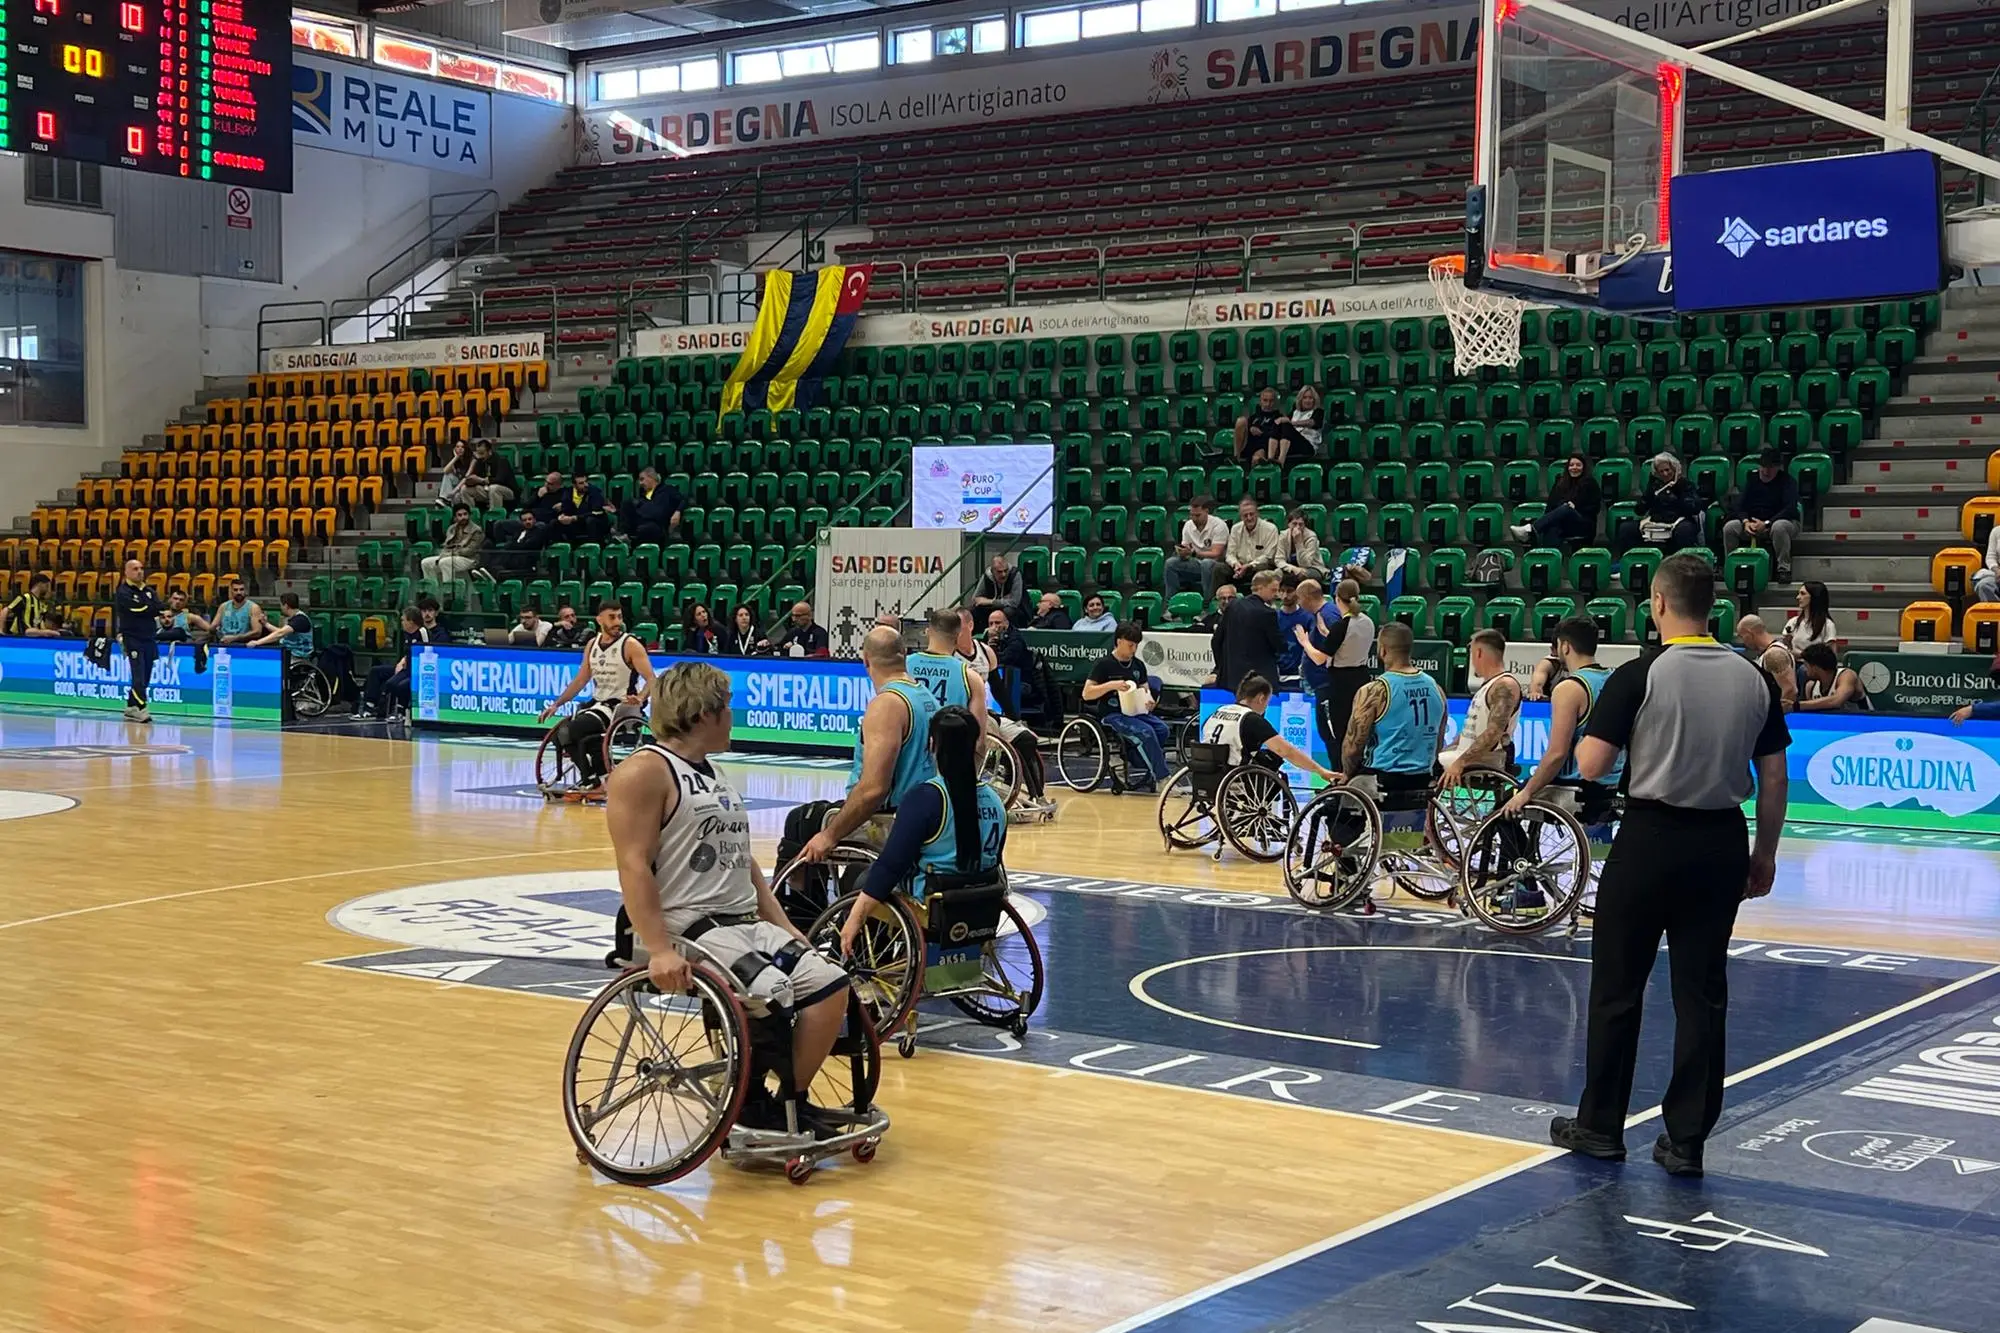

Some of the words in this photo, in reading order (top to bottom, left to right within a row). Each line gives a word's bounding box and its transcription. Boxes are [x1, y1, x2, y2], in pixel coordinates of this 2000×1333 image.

[121, 2, 143, 32] 10
[1206, 17, 1479, 91] SARDEGNA
[344, 76, 477, 136] REALE
[612, 100, 819, 155] SARDEGNA
[830, 102, 893, 128] ISOLA
[898, 80, 1067, 121] dell'Artigianato
[37, 111, 54, 140] 0
[127, 126, 143, 154] 0
[344, 117, 477, 164] MUTUA
[1765, 216, 1888, 247] sardares
[1216, 299, 1336, 322] SARDEGNA
[1341, 300, 1377, 313] ISOLA
[931, 316, 1033, 338] SARDEGNA
[1039, 317, 1068, 331] ISOLA
[677, 331, 753, 350] SARDEGN
[287, 351, 358, 369] SARDEGNA
[461, 341, 540, 360] SARDEGNA
[972, 474, 994, 484] EURO
[974, 486, 992, 495] CUP
[832, 555, 944, 574] SARDEGNA
[1049, 644, 1058, 658] di
[1060, 644, 1108, 661] Sardegna
[1167, 648, 1201, 662] Banco
[1202, 648, 1213, 662] di
[913, 666, 950, 678] SAYARI
[1895, 671, 1944, 689] Banco
[1946, 671, 1960, 688] di
[54, 681, 77, 696] GOOD,
[78, 683, 100, 699] PURE,
[153, 688, 183, 703] GREEN.
[747, 672, 876, 712] SMERALDIN
[1404, 687, 1430, 698] YAVUZ
[1894, 693, 1930, 706] Gruppo
[1931, 695, 1954, 705] BPER
[451, 694, 480, 712] GOOD,
[481, 696, 511, 714] PURE,
[512, 698, 542, 715] COOL,
[1409, 698, 1428, 726] 11
[747, 710, 780, 730] GOOD,
[784, 712, 817, 733] PURE,
[820, 714, 855, 735] COOL,
[1210, 723, 1224, 744] 9
[681, 772, 710, 796] 24
[1830, 755, 1976, 792] SMERALDINA
[1008, 873, 1191, 898] BLUE
[353, 905, 573, 954] MUTUA
[415, 898, 615, 947] REALE
